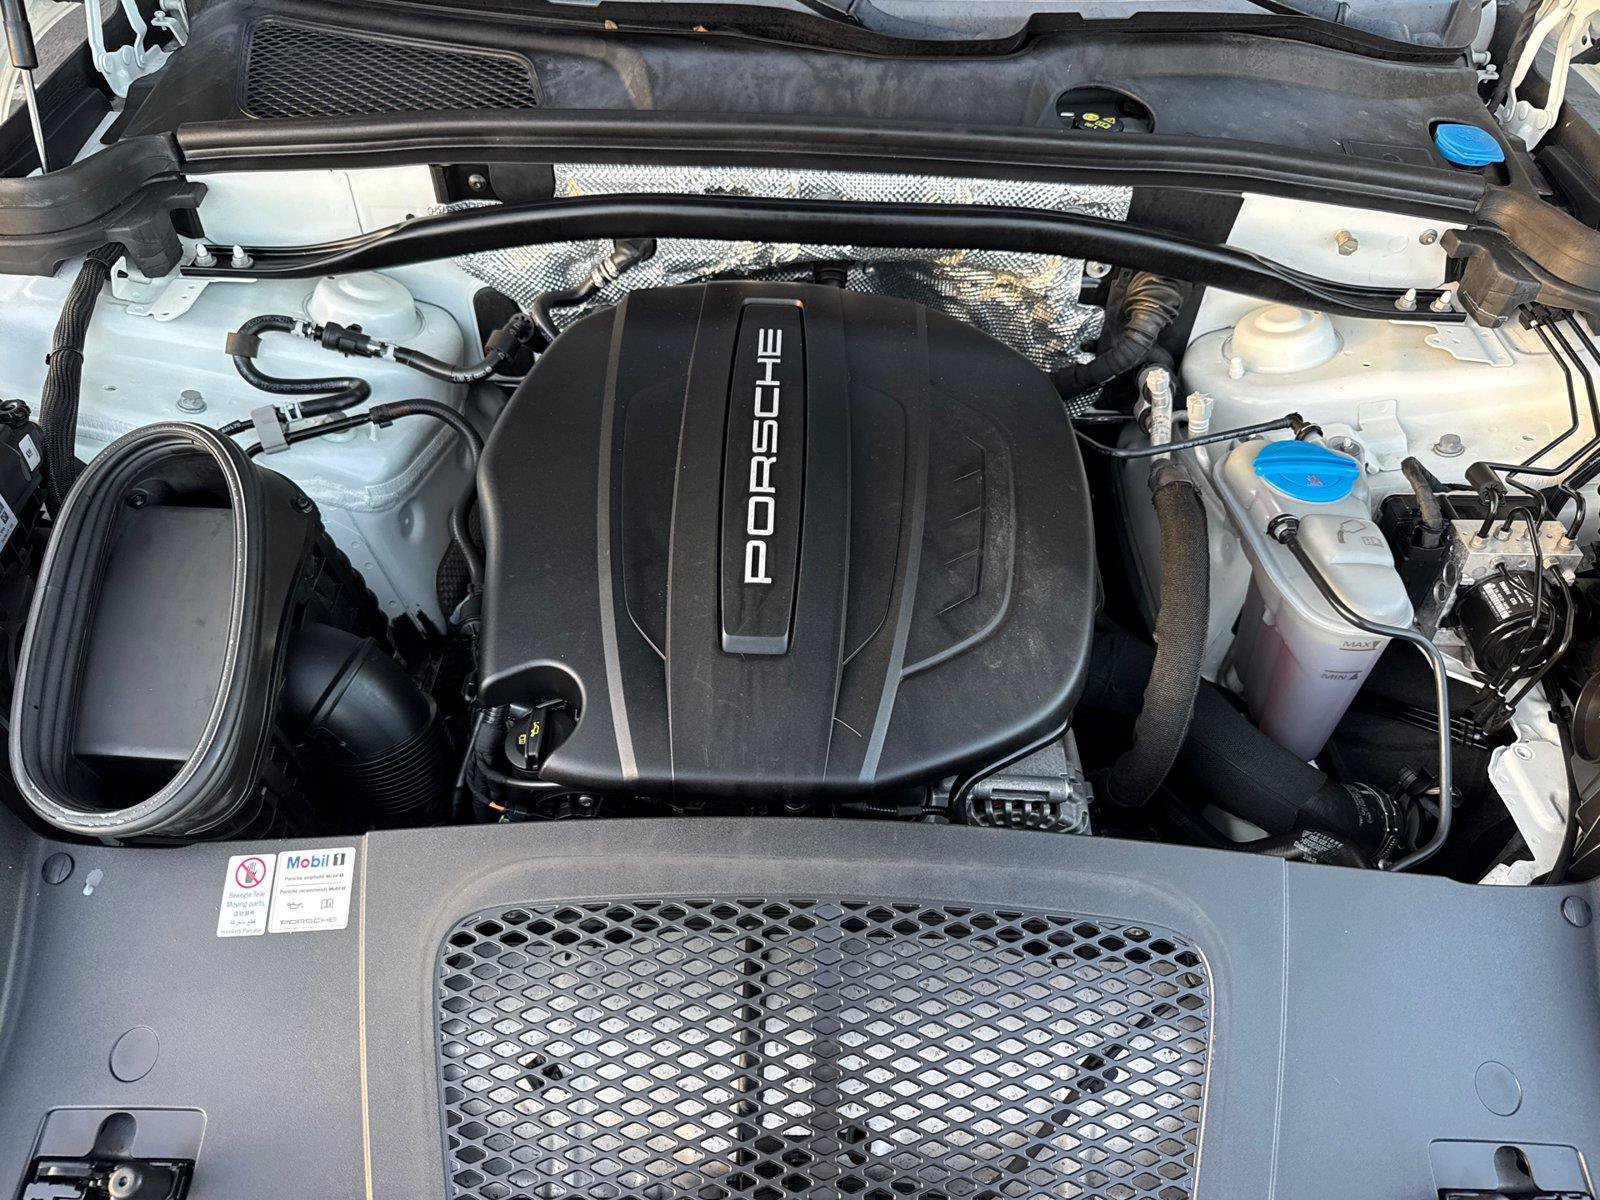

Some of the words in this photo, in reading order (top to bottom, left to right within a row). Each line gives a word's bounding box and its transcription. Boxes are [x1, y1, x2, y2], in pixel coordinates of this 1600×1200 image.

[744, 328, 783, 585] PORSCHE
[1342, 640, 1371, 648] MAX
[287, 854, 330, 869] Mobil
